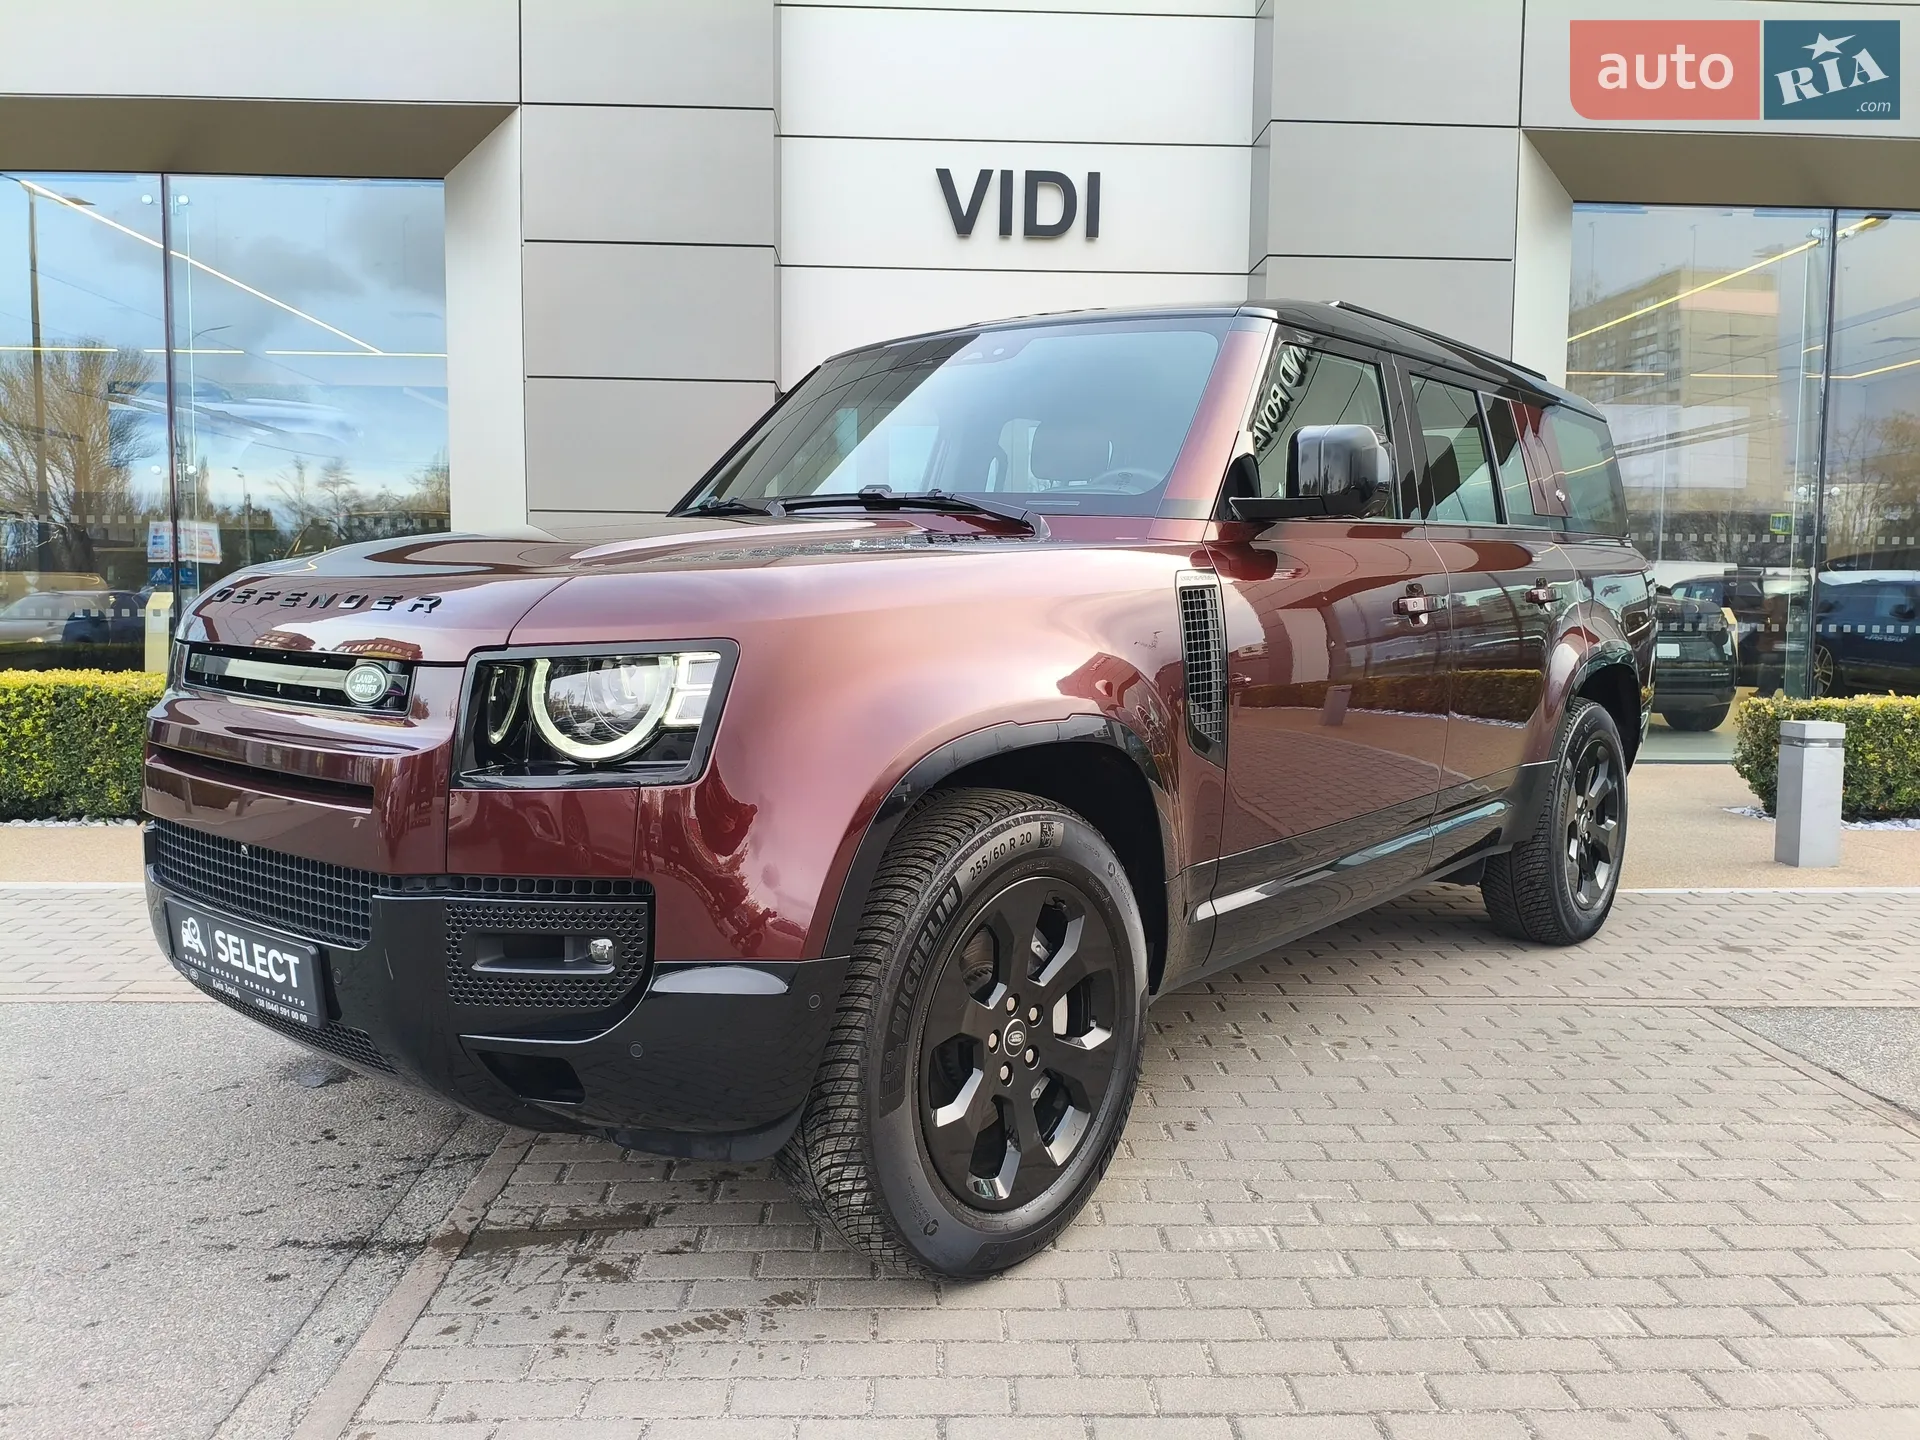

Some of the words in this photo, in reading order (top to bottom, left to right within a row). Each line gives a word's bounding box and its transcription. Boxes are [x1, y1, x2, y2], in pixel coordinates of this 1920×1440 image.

[935, 168, 1101, 238] VIDI
[211, 587, 442, 614] DEFENDER
[354, 673, 374, 684] LAND
[354, 683, 377, 694] ROVER
[969, 843, 1006, 881] 255/60
[1009, 837, 1016, 850] R
[1020, 831, 1032, 846] 20
[214, 929, 300, 988] SELECT
[891, 885, 959, 1034] MICHELIN
[282, 993, 305, 1007] АВТО
